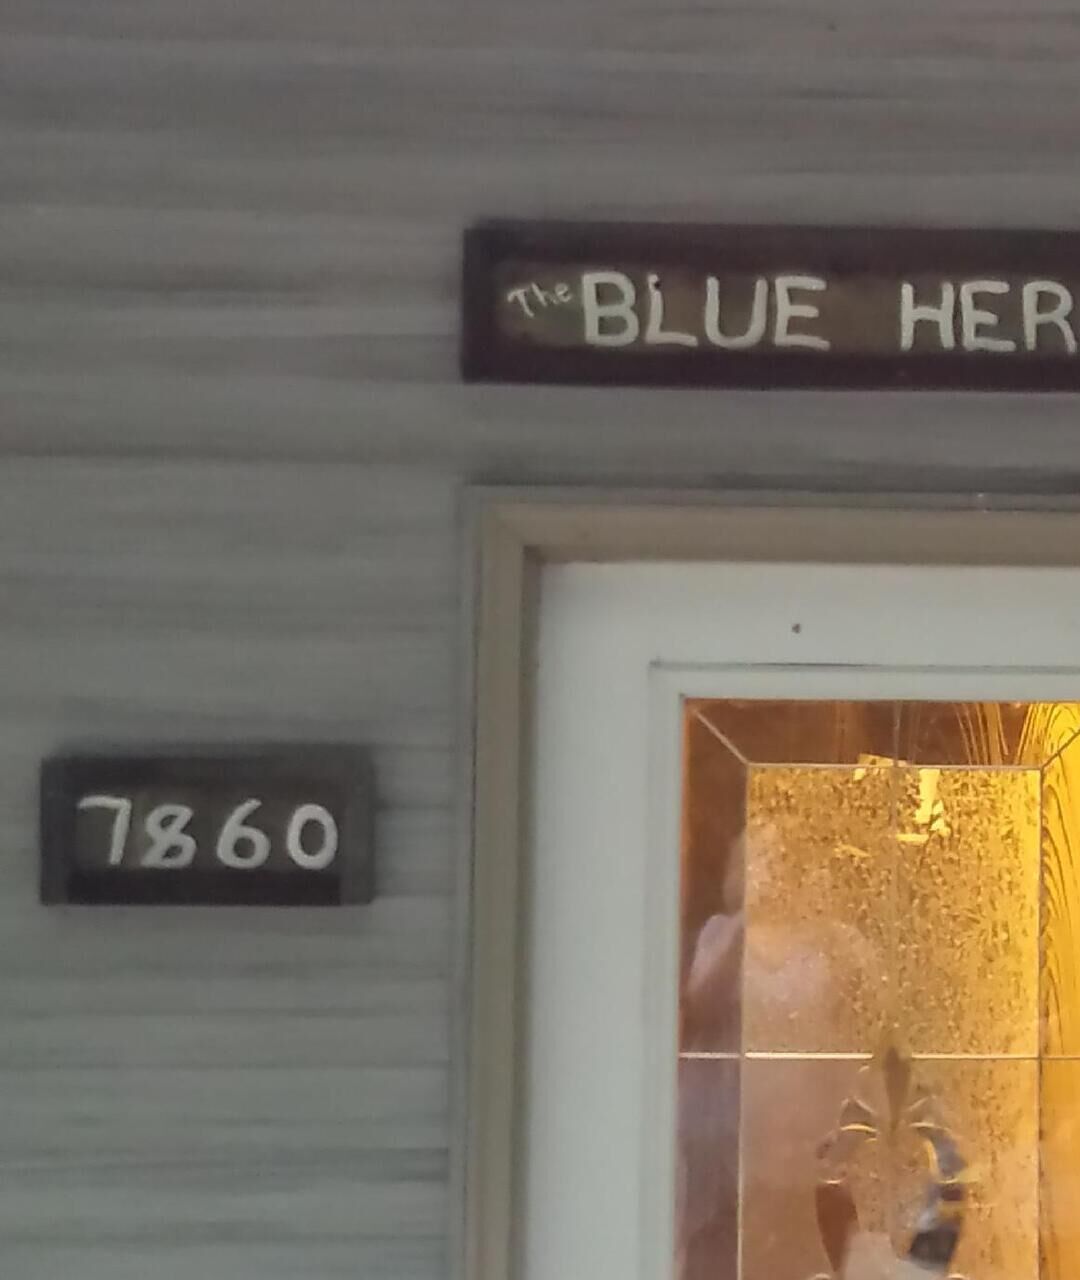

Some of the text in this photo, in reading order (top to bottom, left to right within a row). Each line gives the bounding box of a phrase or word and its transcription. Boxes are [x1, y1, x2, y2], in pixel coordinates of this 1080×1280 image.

[507, 281, 573, 318] The
[582, 271, 830, 351] BLUE
[77, 795, 338, 869] 7860
